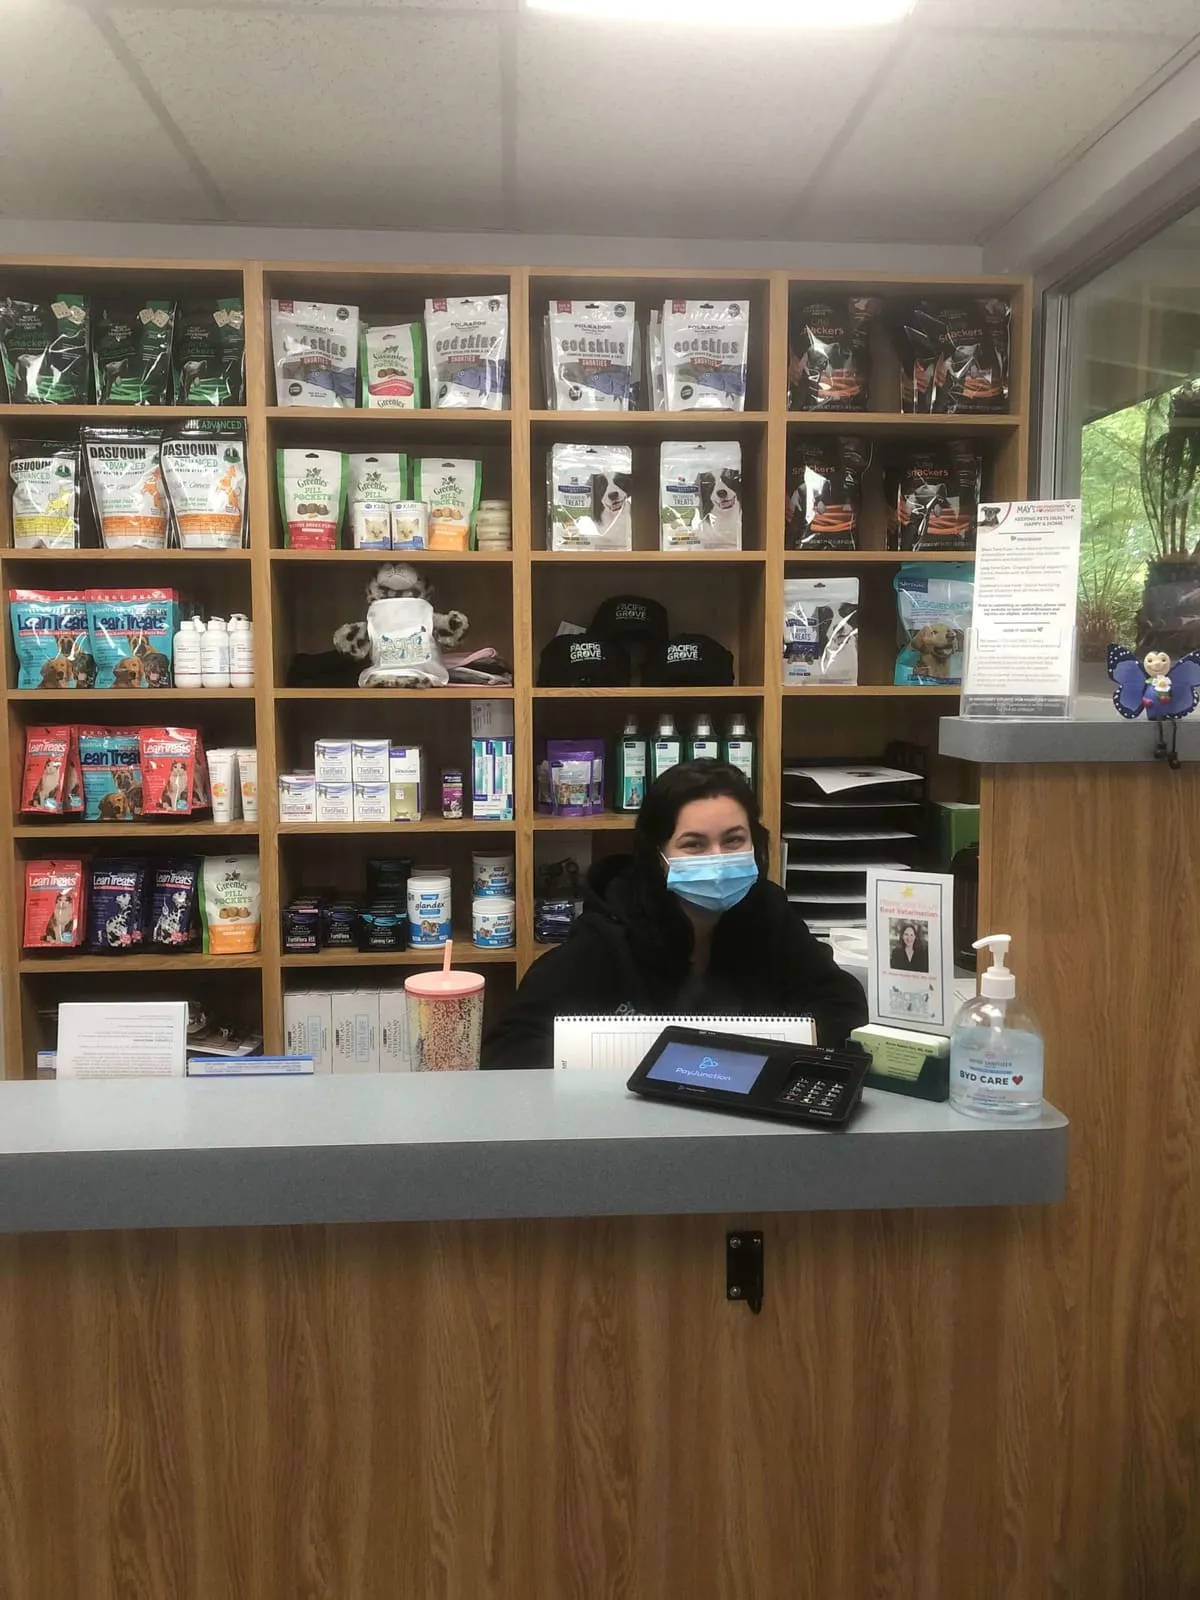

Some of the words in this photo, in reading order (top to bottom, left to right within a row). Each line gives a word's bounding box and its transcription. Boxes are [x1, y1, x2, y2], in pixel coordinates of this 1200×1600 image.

[310, 336, 347, 357] skins
[436, 336, 458, 352] cod
[460, 334, 498, 350] skins
[561, 338, 586, 352] cod
[588, 338, 624, 354] skins
[674, 338, 699, 352] cod
[701, 338, 738, 354] skins
[200, 420, 242, 429] ADVANCED
[89, 446, 146, 460] DASUQUIN
[297, 476, 328, 490] Greenies
[357, 482, 388, 493] Greenies
[434, 486, 464, 496] Greenies
[1017, 504, 1036, 514] MAY'S
[616, 610, 646, 618] GROVE
[570, 643, 601, 652] PACIFIC
[668, 644, 698, 654] PACIFIC
[570, 650, 602, 660] GROVE
[667, 652, 698, 660] GROVE
[216, 881, 248, 892] Greenies
[214, 896, 252, 904] POCKETS
[415, 901, 445, 910] glandex
[984, 1060, 1012, 1068] SANITIZER
[675, 1067, 732, 1080] PayJunction
[960, 1070, 976, 1080] BYD
[980, 1076, 1008, 1085] CARE
